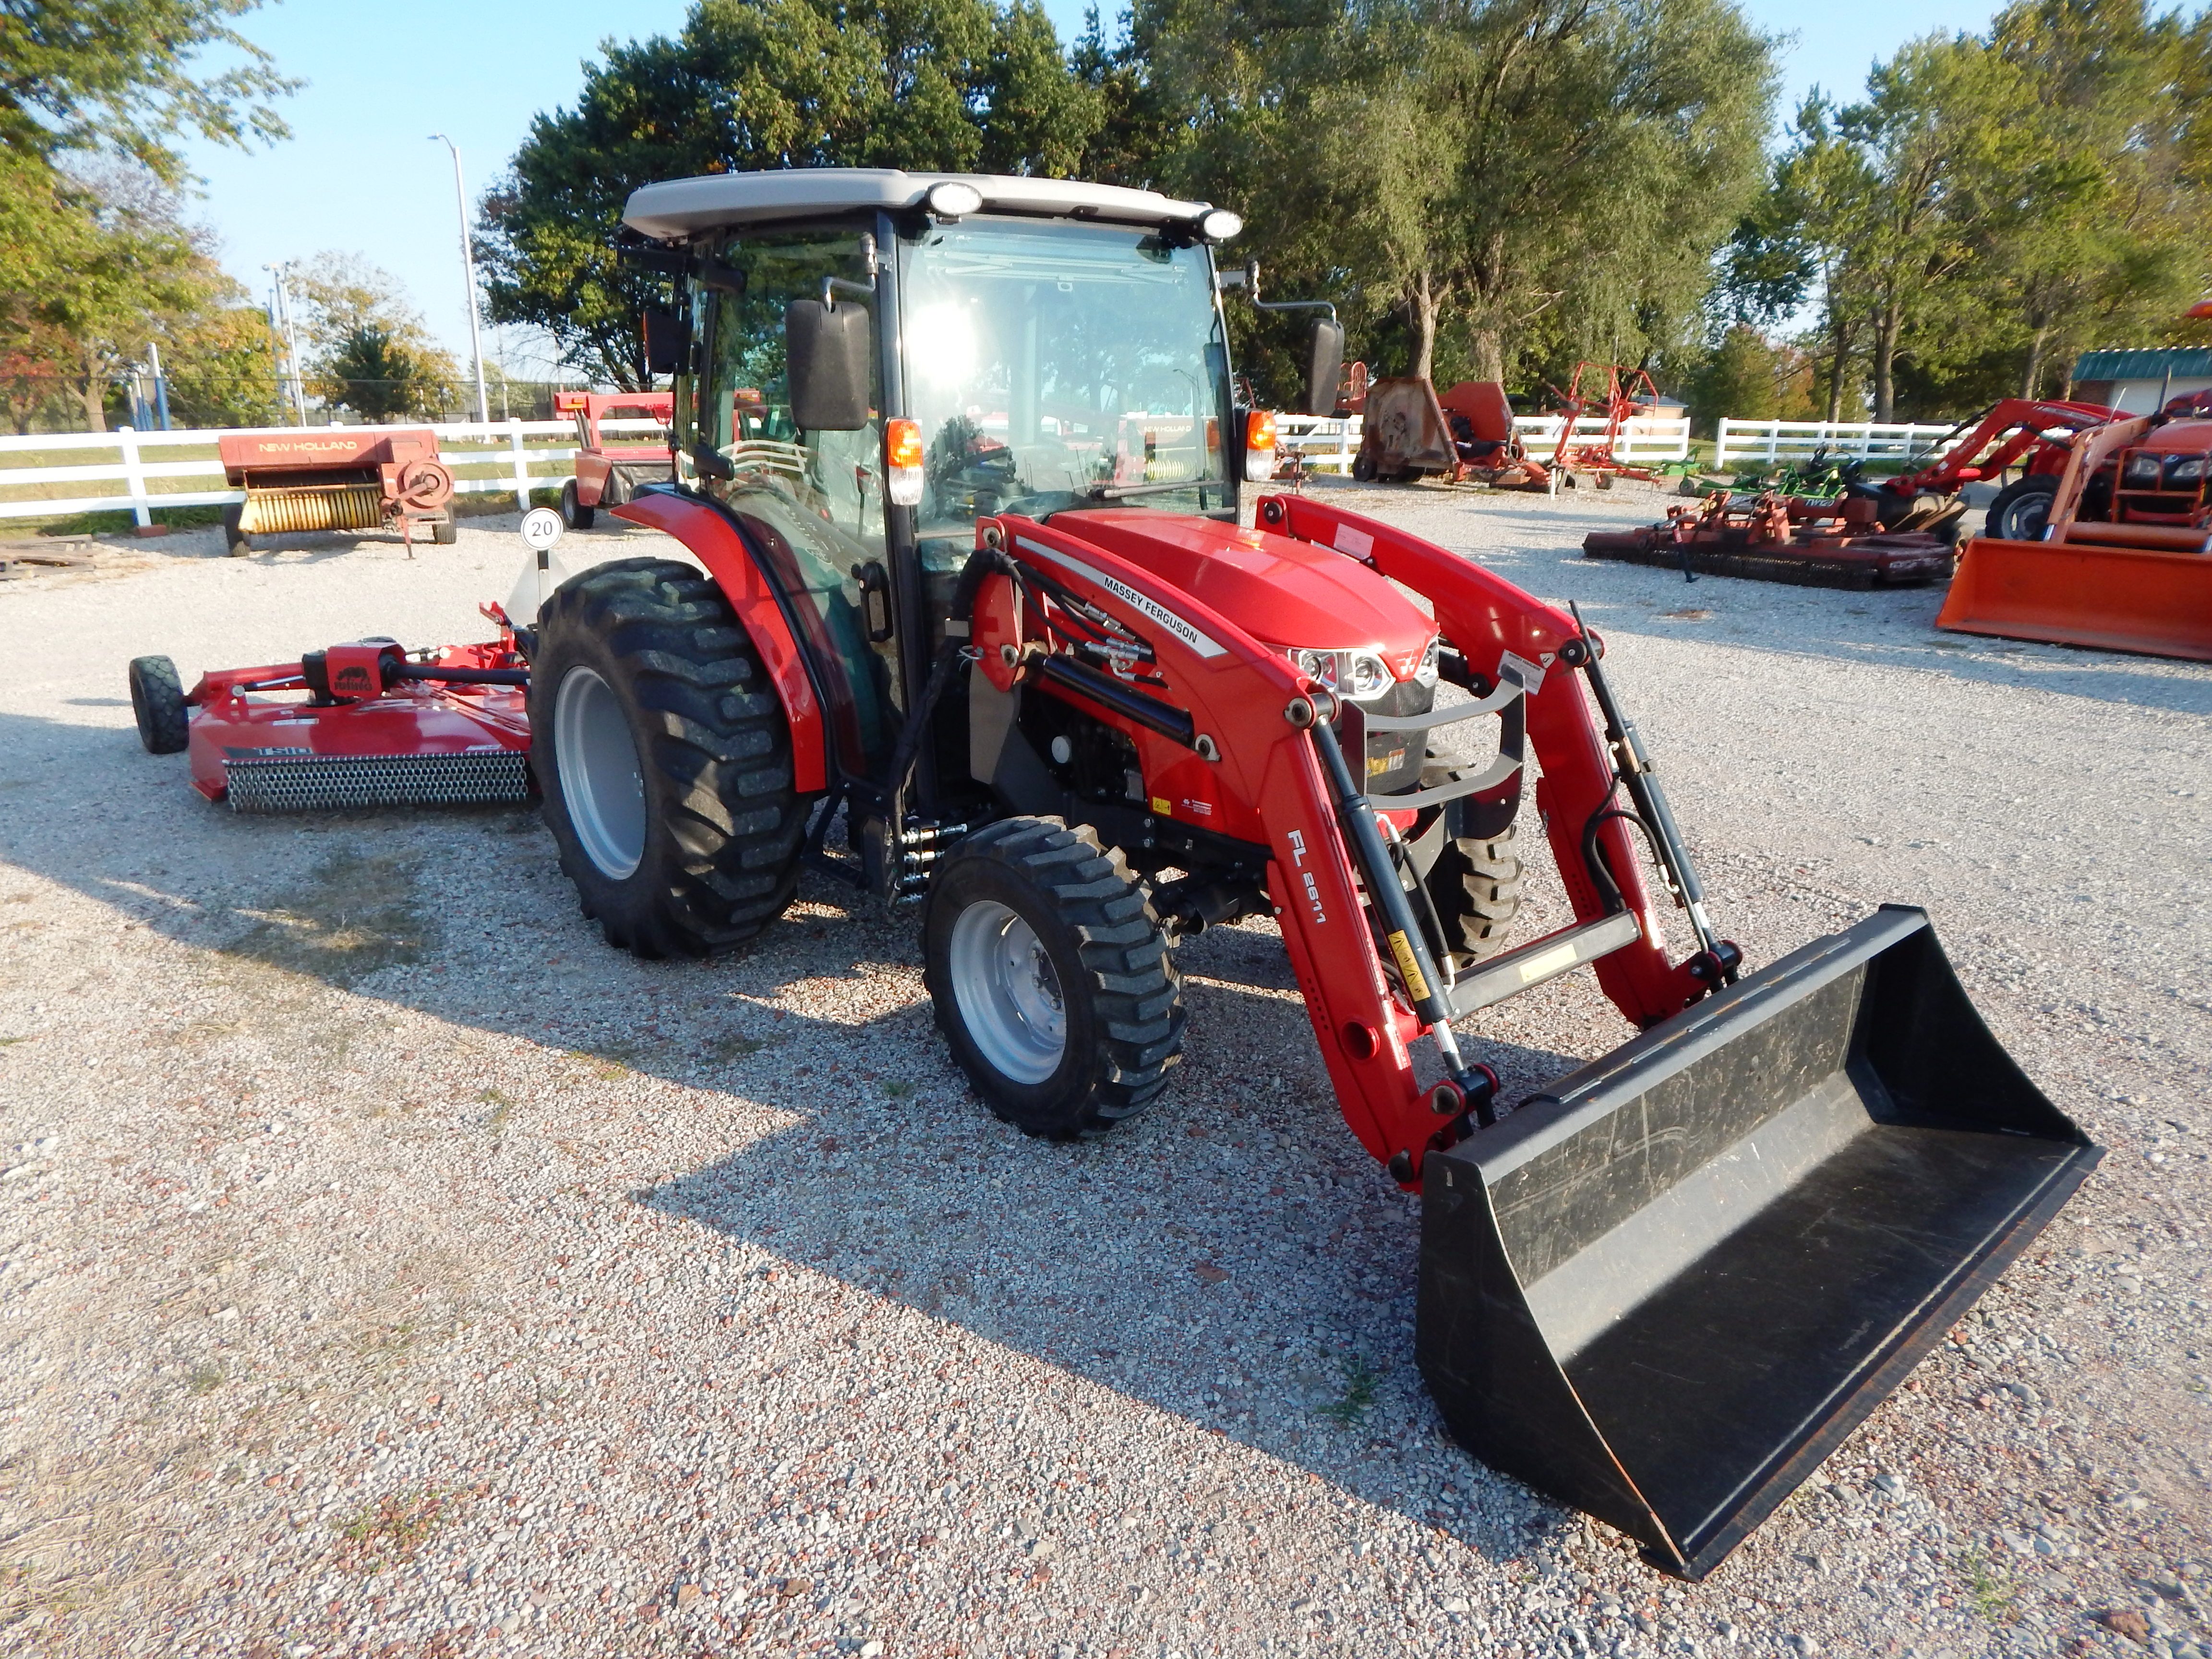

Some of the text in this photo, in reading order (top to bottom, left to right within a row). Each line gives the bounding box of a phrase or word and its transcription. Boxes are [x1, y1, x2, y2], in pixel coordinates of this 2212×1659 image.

[259, 441, 358, 452] NEW HOLLAND
[532, 521, 553, 537] 20
[1104, 577, 1198, 644] MASSEY FERGUSON
[1287, 829, 1327, 924] FL 2611
